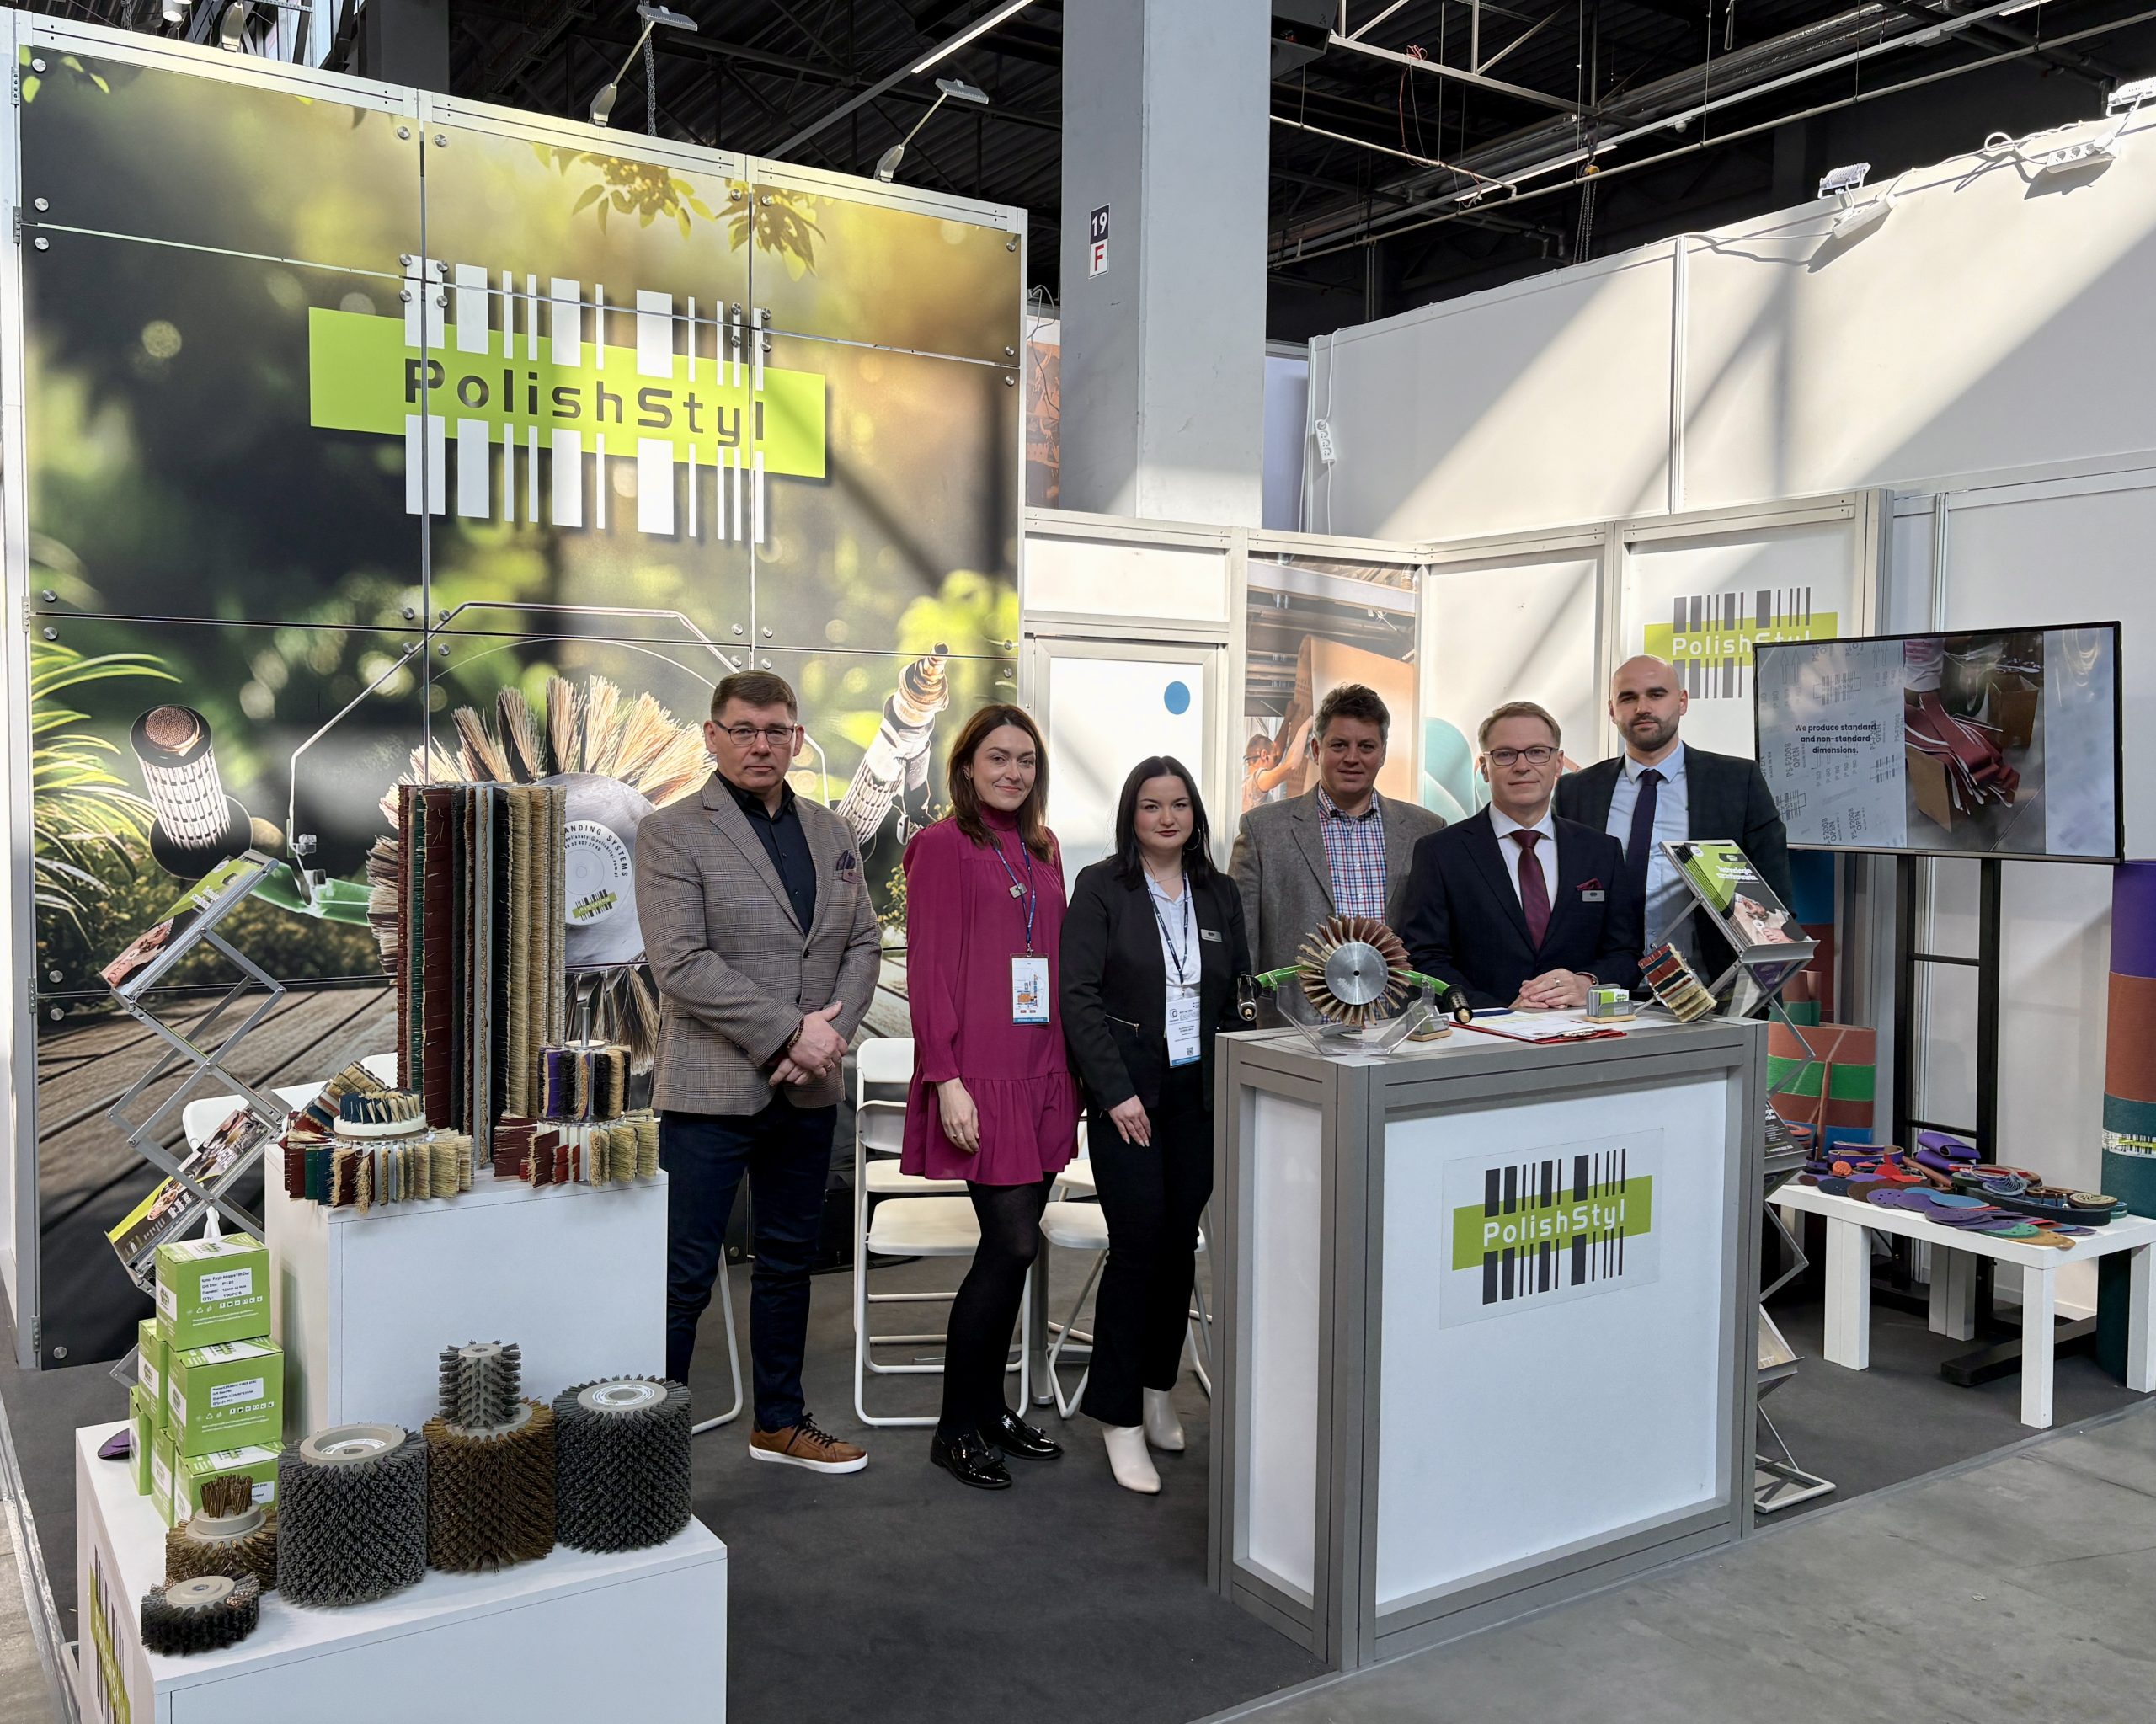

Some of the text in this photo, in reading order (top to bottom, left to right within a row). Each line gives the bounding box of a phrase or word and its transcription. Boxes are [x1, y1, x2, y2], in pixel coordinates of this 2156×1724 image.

[1092, 212, 1107, 237] 19
[1095, 244, 1104, 271] F
[405, 358, 764, 447] PolishStyl
[1673, 631, 1810, 656] PolishStl
[1808, 724, 1839, 733] produce
[564, 825, 628, 877] ANDING SYSTEMS
[1484, 1198, 1625, 1247] PolishStyl
